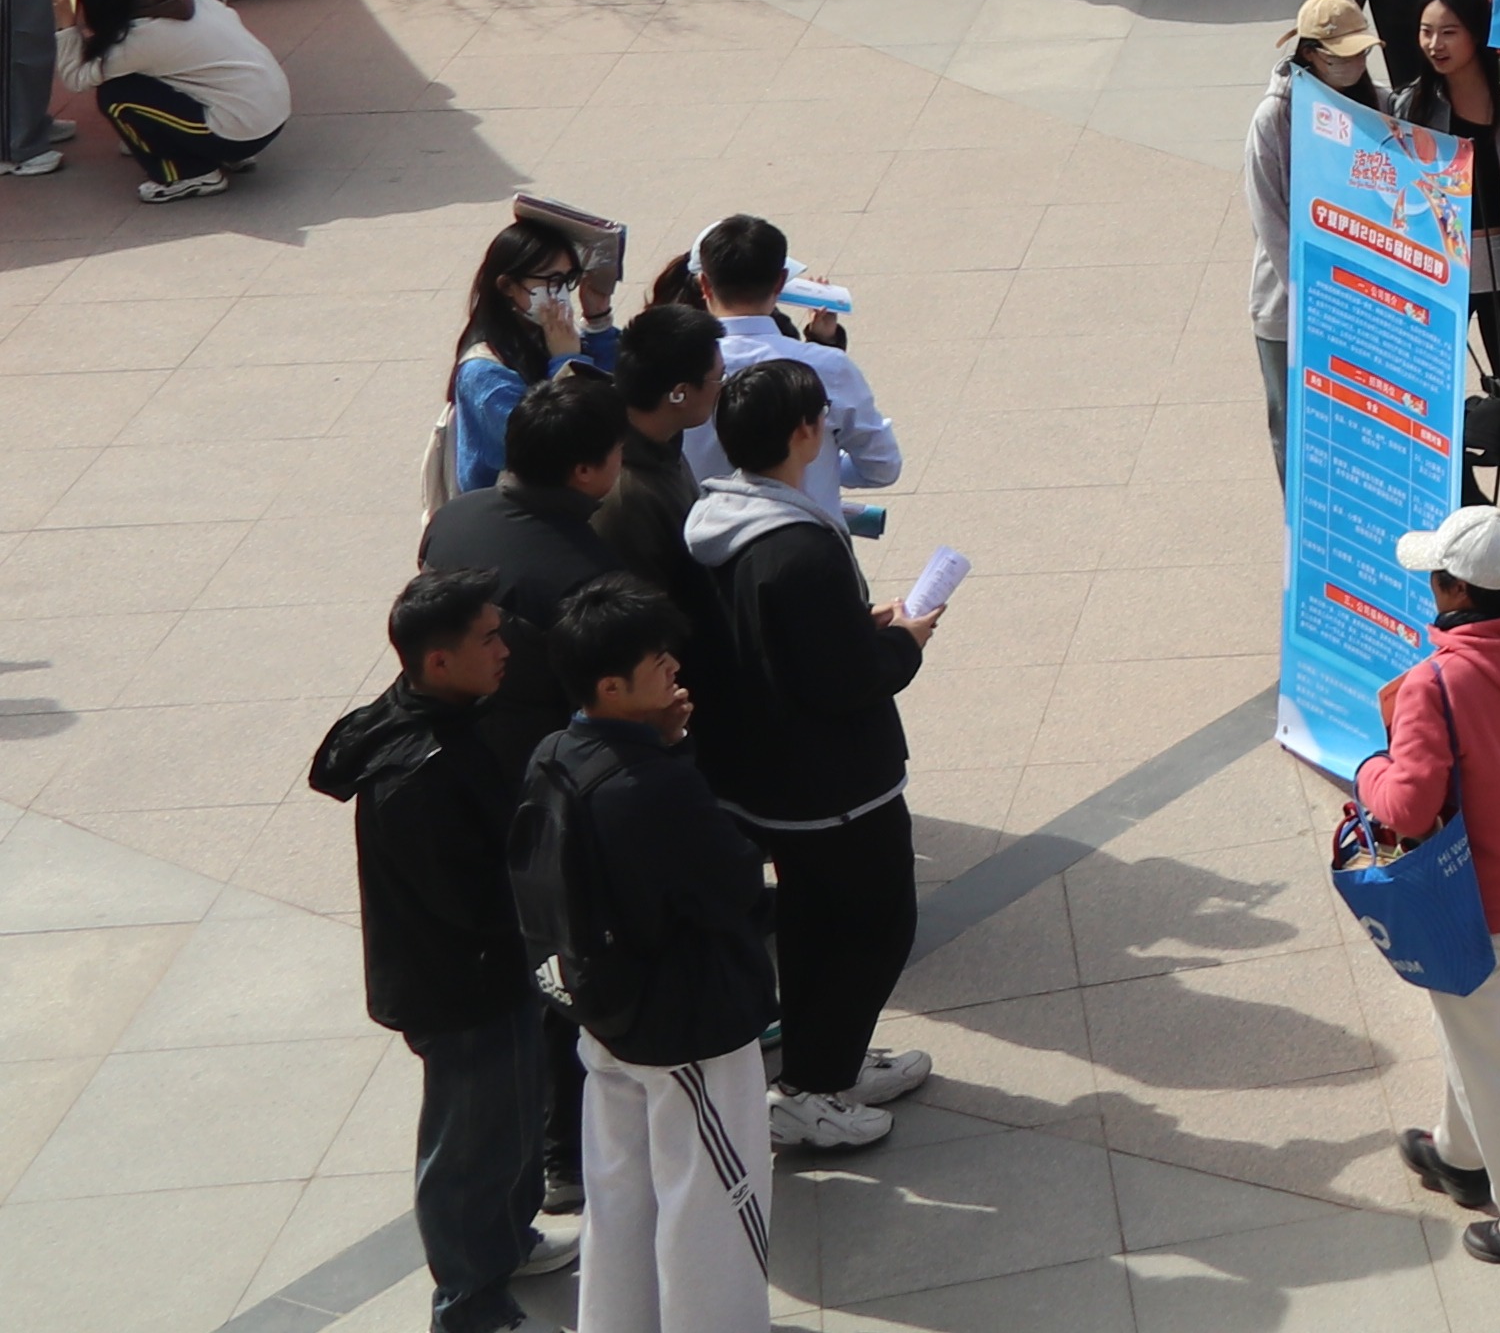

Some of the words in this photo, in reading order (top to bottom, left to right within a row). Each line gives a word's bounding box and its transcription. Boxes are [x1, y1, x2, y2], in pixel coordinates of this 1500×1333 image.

[1316, 205, 1444, 281] 宁夏伊利2026届校园招聘
